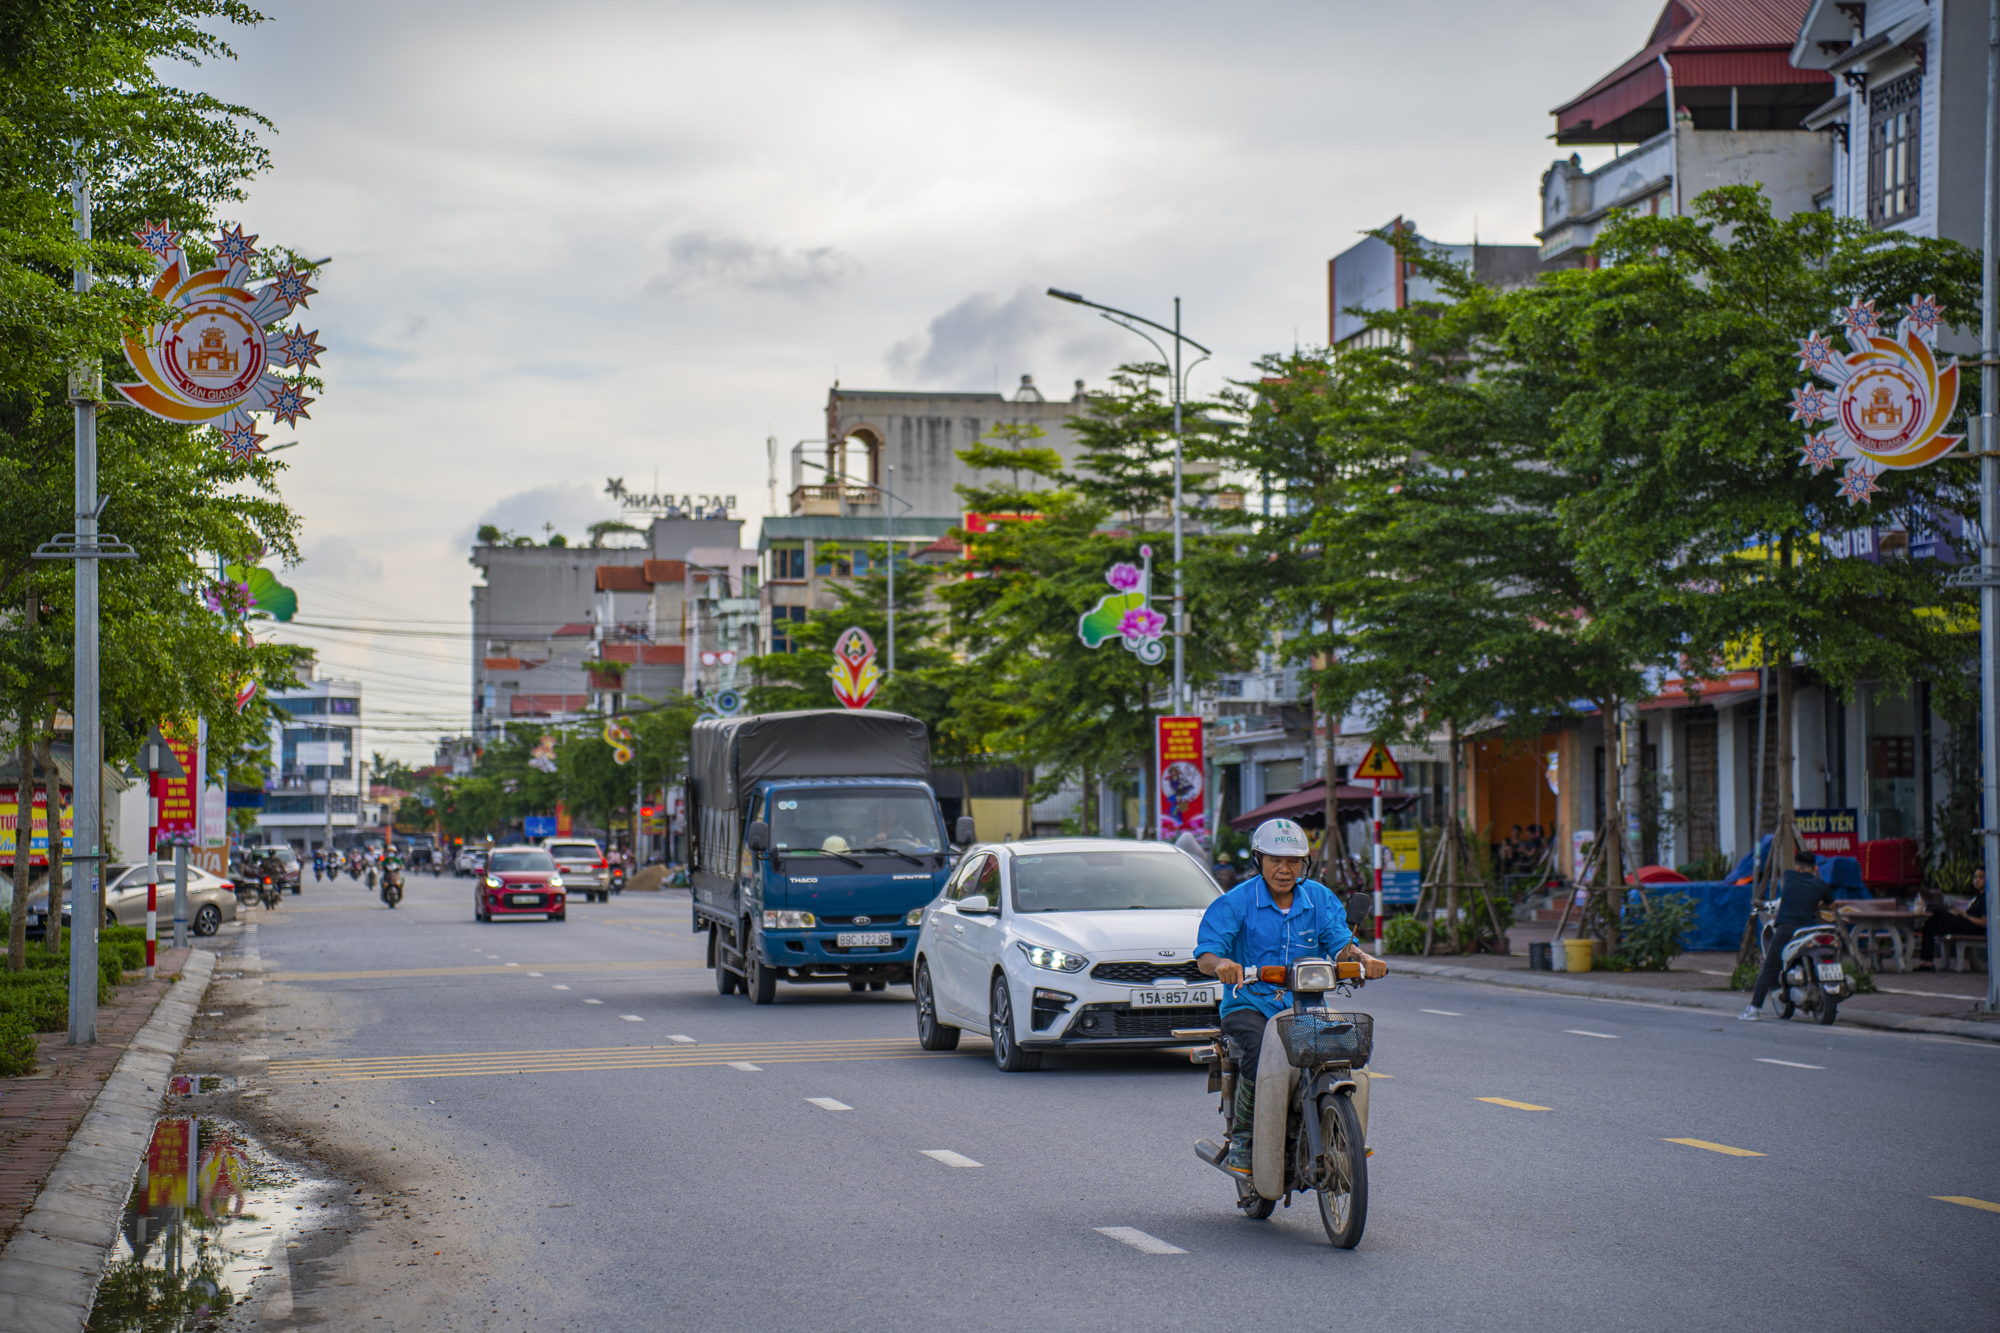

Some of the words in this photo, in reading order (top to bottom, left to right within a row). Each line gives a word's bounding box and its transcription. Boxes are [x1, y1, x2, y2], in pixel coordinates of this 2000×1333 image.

[207, 385, 241, 400] GIANG
[1878, 436, 1906, 450] GIANG
[1275, 836, 1299, 844] PEGA
[839, 934, 890, 946] 89C-122.95
[1140, 991, 1207, 1005] 15A-857.40
